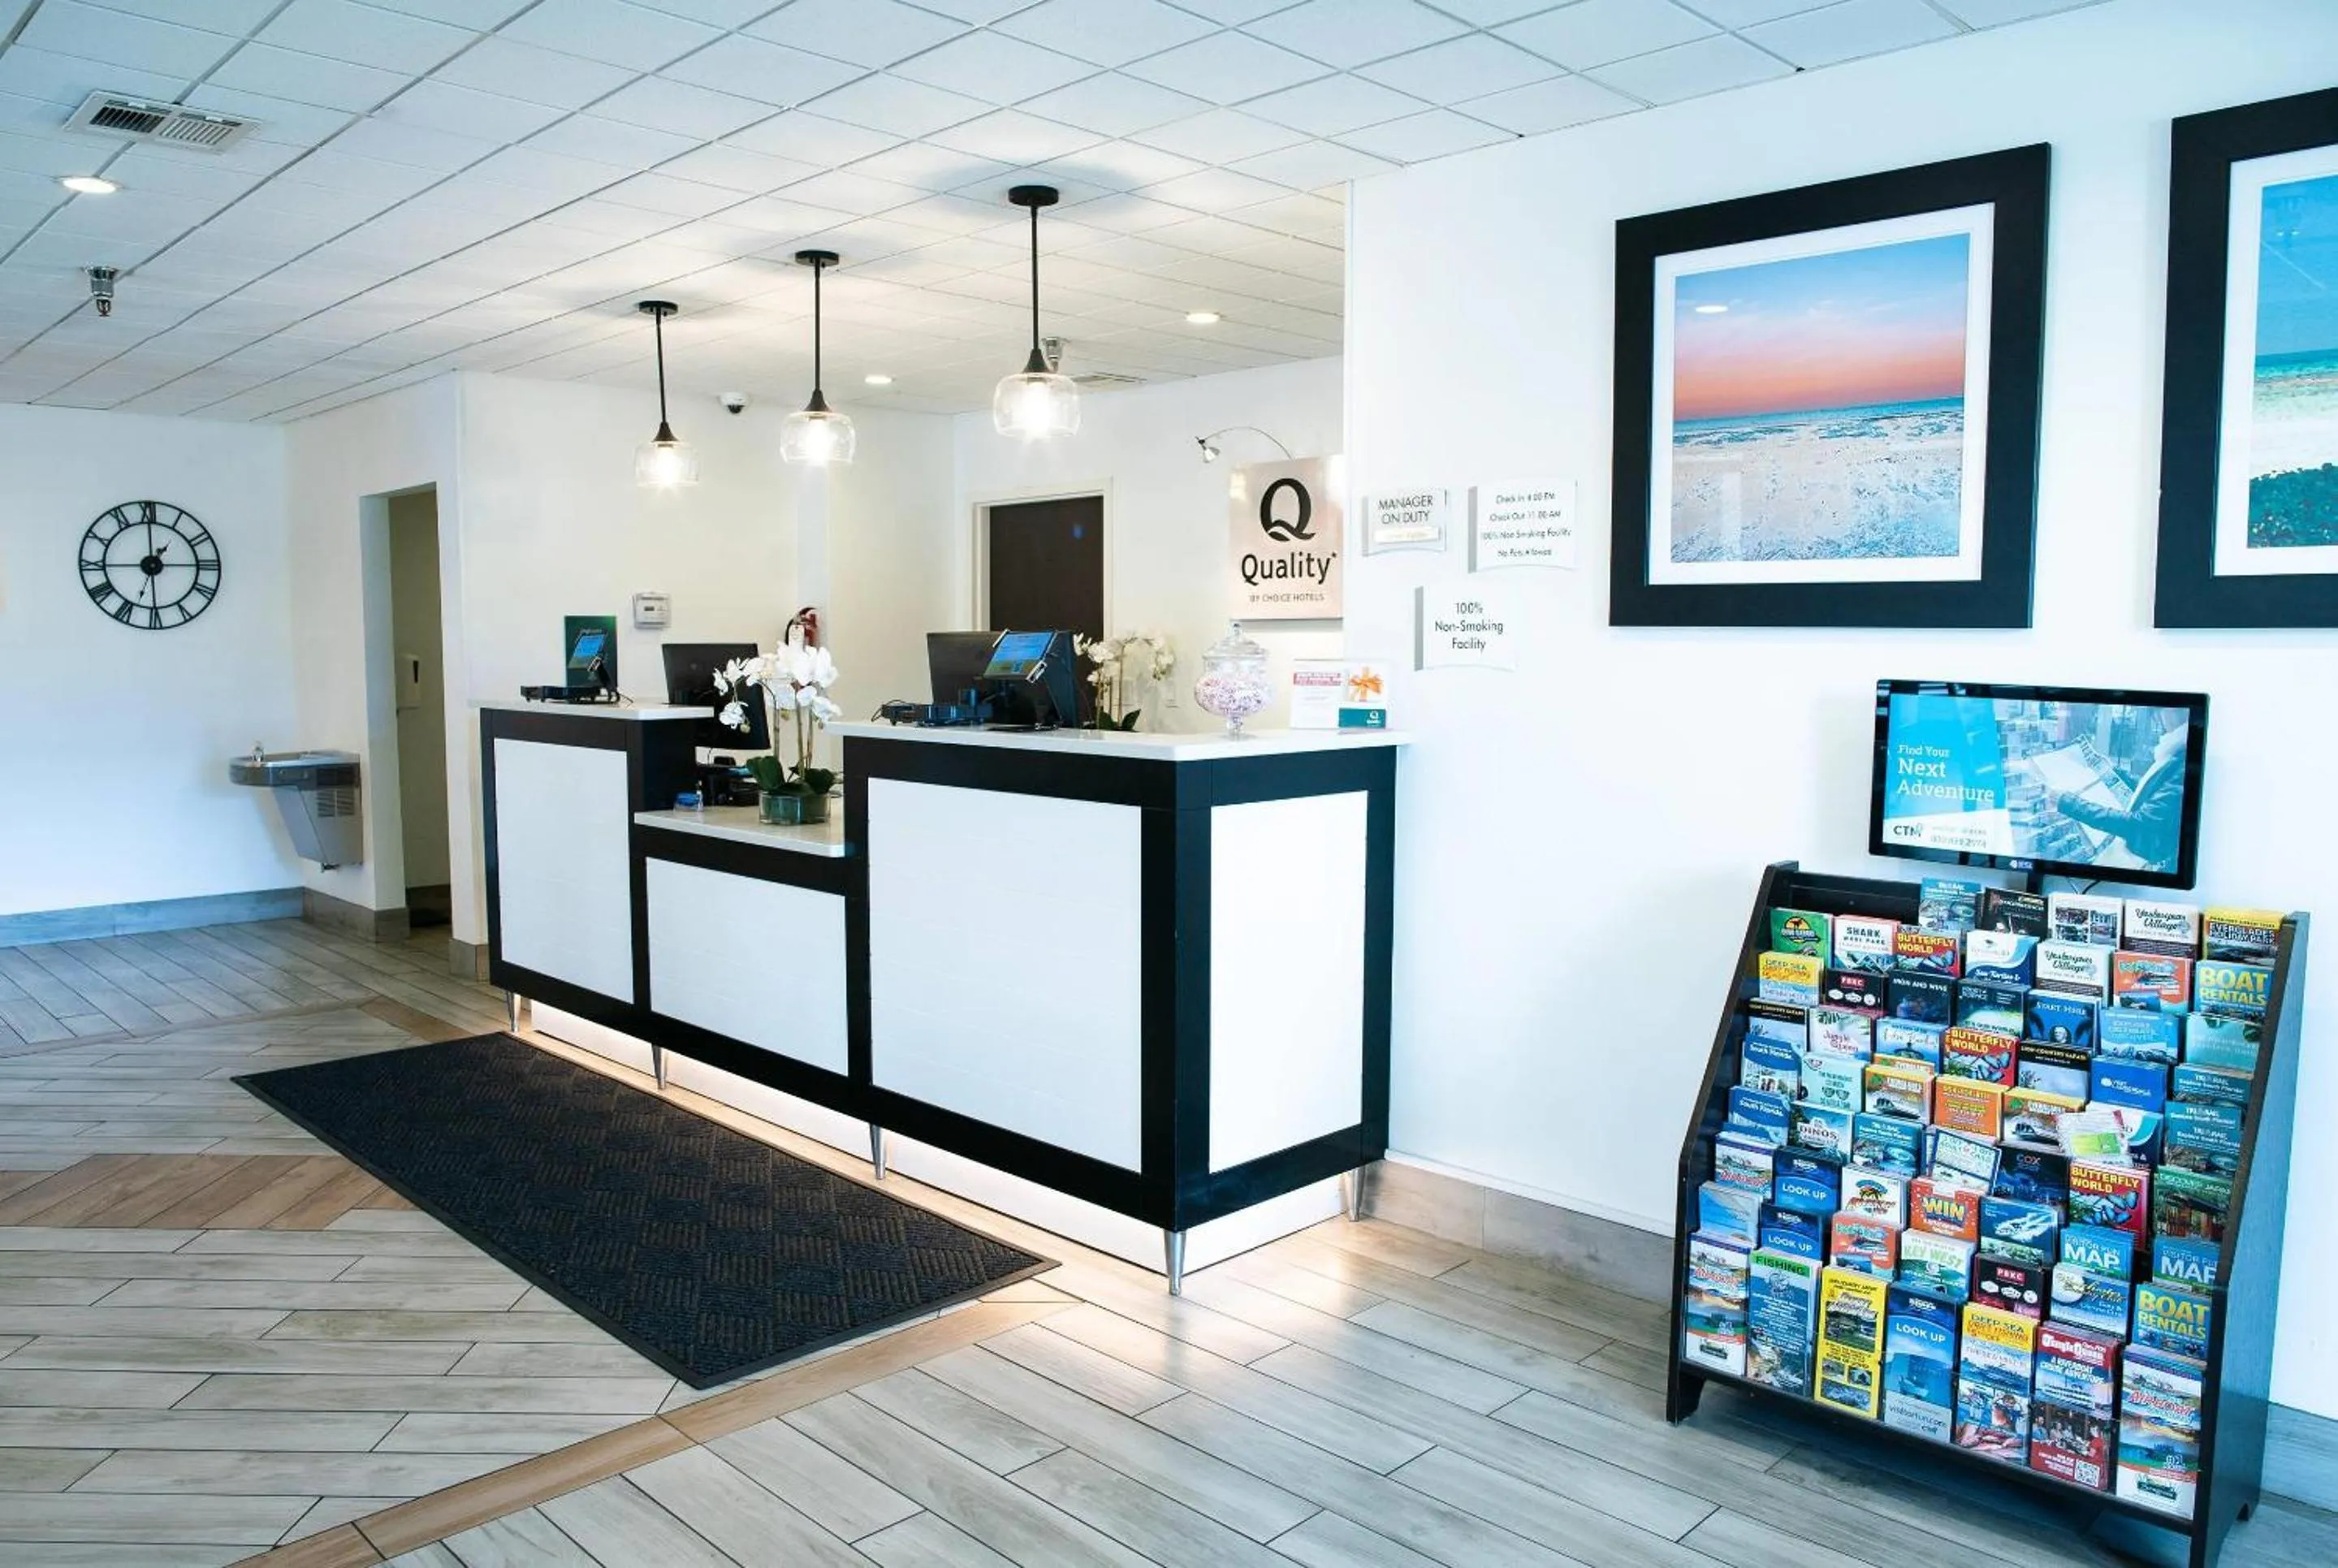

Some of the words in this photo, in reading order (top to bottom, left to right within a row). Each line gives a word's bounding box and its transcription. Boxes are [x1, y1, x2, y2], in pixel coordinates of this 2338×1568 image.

[1260, 477, 1316, 542] Q
[1378, 495, 1433, 511] MANAGER
[1382, 513, 1401, 525] ON
[1403, 511, 1430, 523] DUTY
[1242, 553, 1332, 585] Quality
[1262, 594, 1291, 603] CHOICE
[1293, 594, 1325, 602] HOTELS
[1455, 602, 1484, 615] 100%
[1434, 620, 1503, 635] Non-Smoking
[1452, 637, 1486, 651] Facility
[1898, 745, 1923, 755] Find
[1925, 746, 1951, 758] Your
[1898, 758, 1947, 778] Next
[1897, 779, 1994, 802] Adventure
[1846, 927, 1881, 938] SHARK
[2144, 918, 2178, 933] Village
[1897, 934, 1954, 948] BUTTERFLY
[1897, 943, 1934, 955] WORLD
[2199, 968, 2268, 991] BOAT
[2199, 987, 2267, 1006] RENTALS
[1951, 1030, 2012, 1050] BUTTERFLY
[1951, 1038, 1989, 1053] WORLD
[2072, 1167, 2140, 1189] BUTTERFLY
[2072, 1177, 2113, 1193] WORLD
[1783, 1183, 1810, 1195] LOOK
[1813, 1191, 1827, 1199] UP
[1921, 1197, 1965, 1221] WIN
[1768, 1235, 1796, 1248] LOOK
[1799, 1243, 1813, 1252] UP
[2064, 1242, 2120, 1269] MAP
[1756, 1255, 1805, 1276] FISHING
[2138, 1290, 2209, 1324] BOAT
[1970, 1313, 2000, 1326] DEEP
[2004, 1321, 2025, 1333] SEA
[2137, 1311, 2206, 1338] RENTALS
[1895, 1322, 1928, 1338] LOOK
[1930, 1331, 1947, 1343] UP
